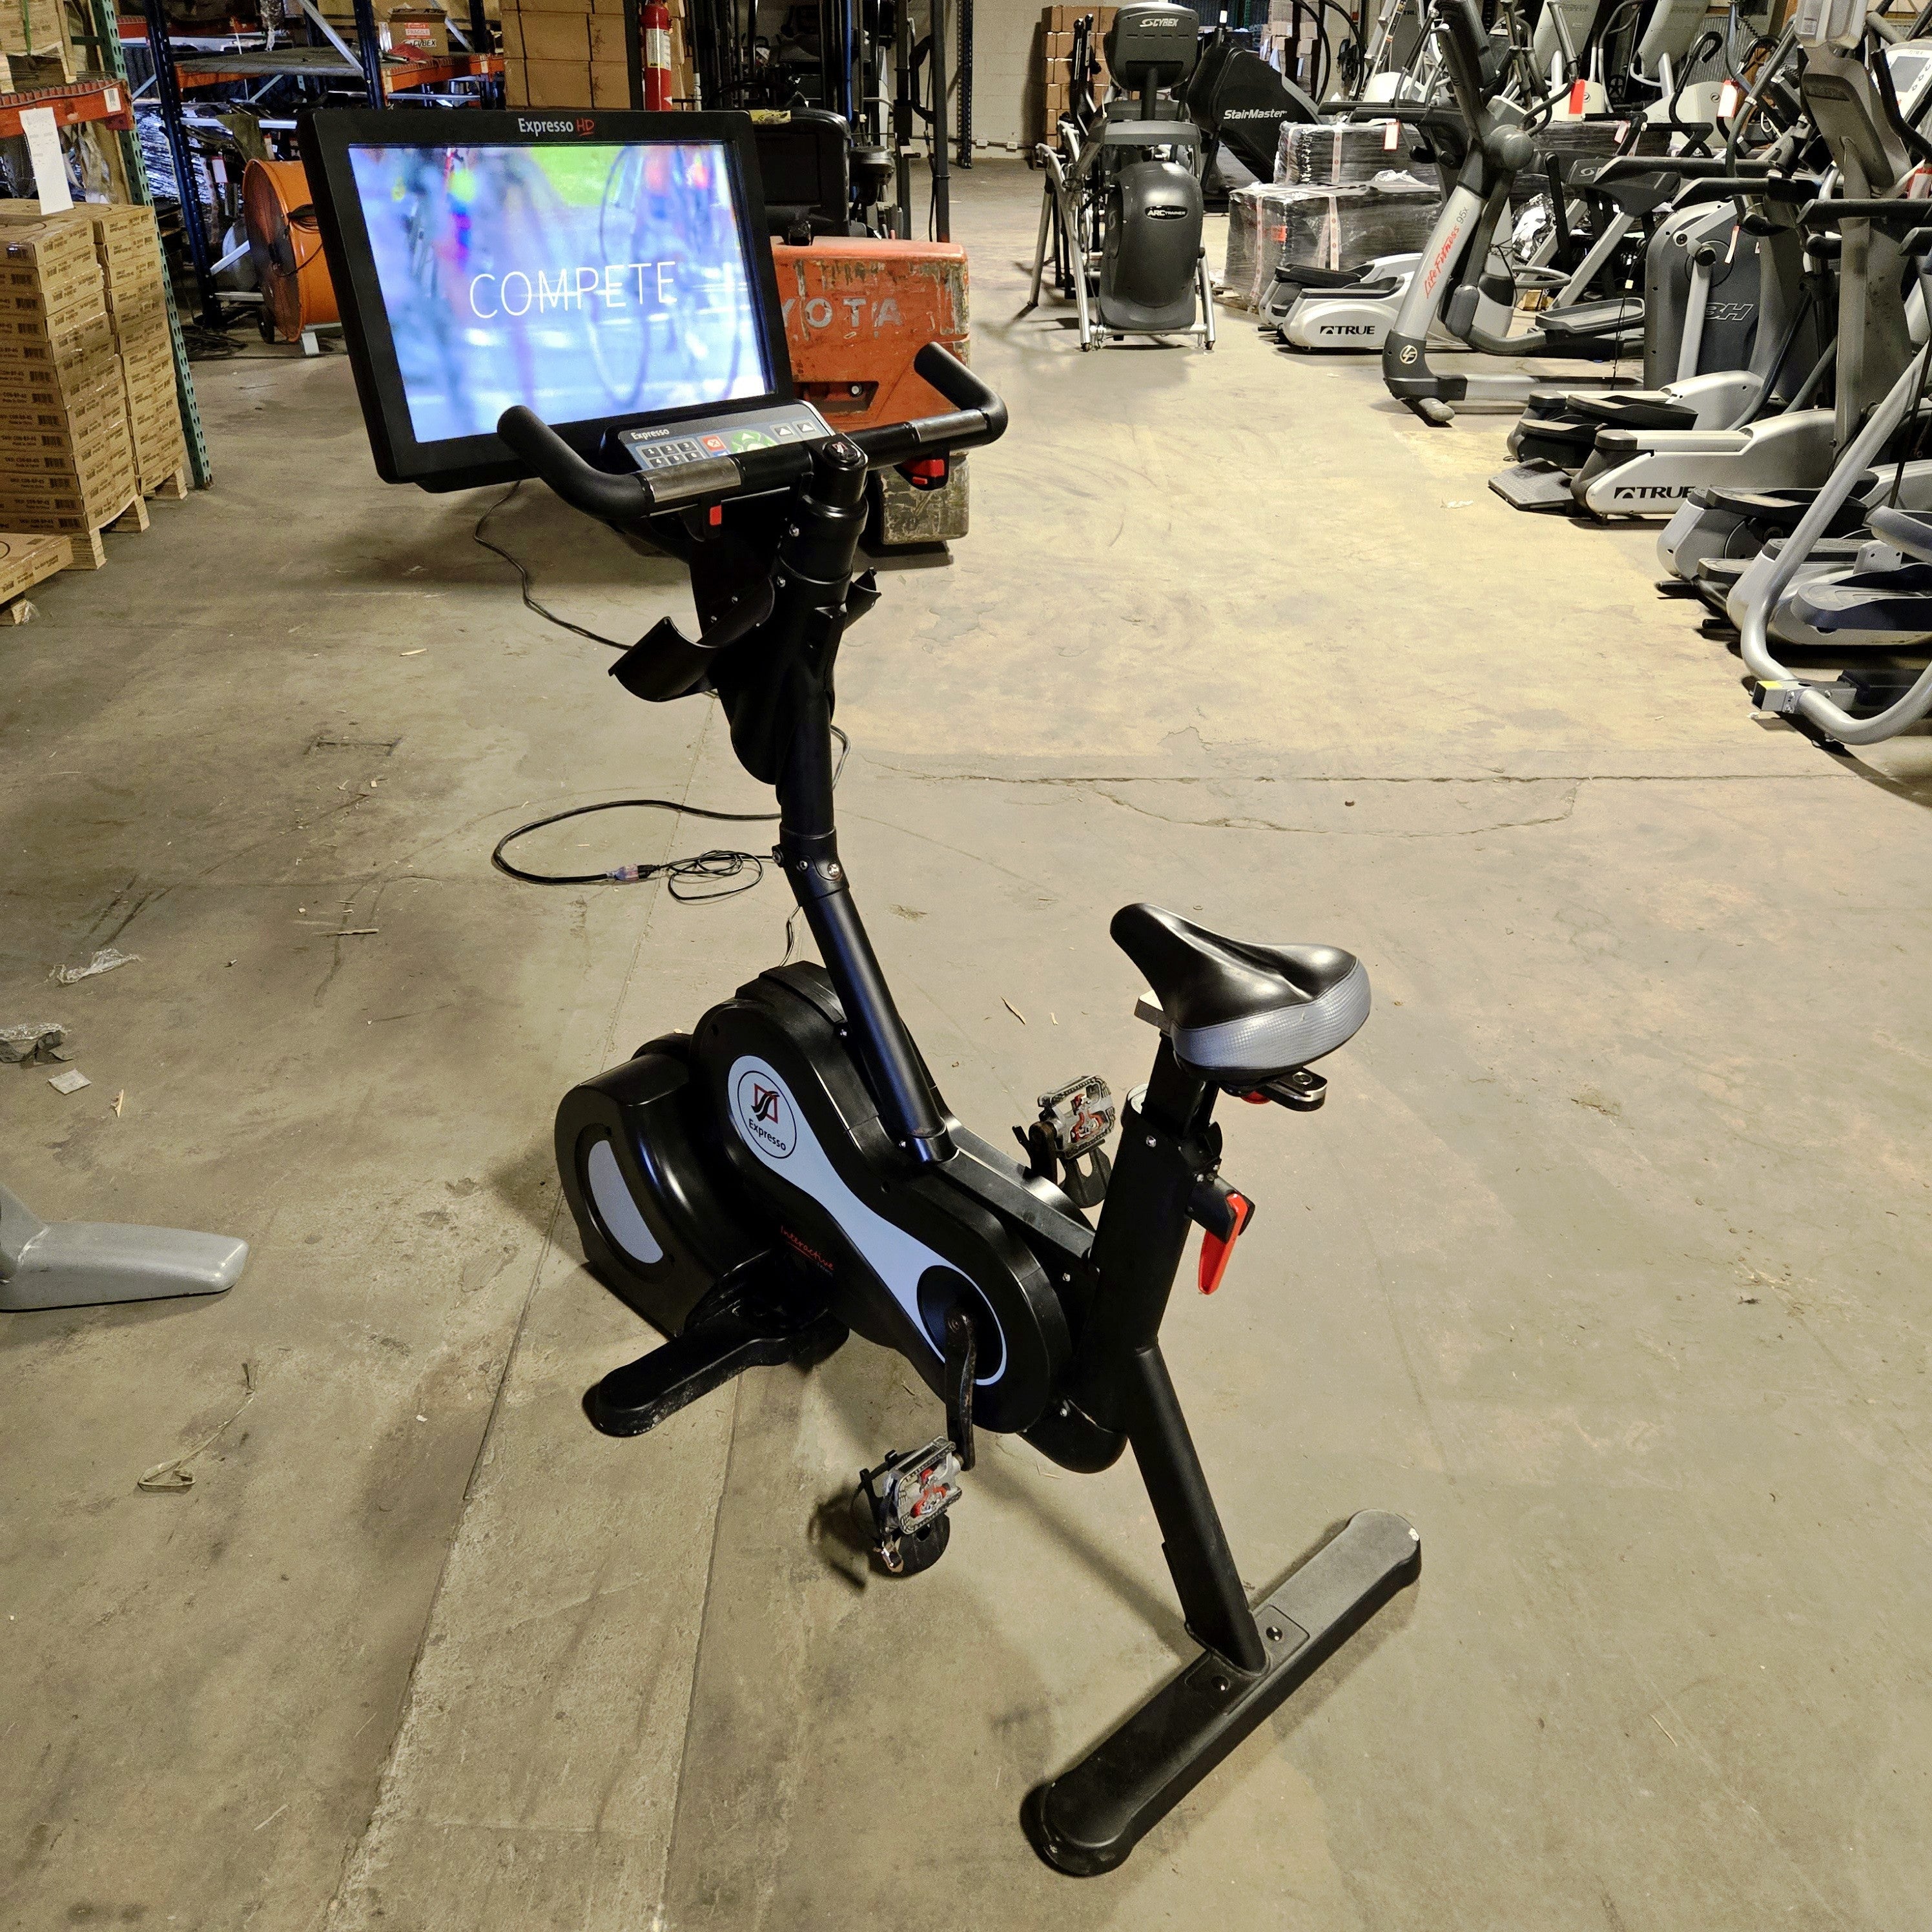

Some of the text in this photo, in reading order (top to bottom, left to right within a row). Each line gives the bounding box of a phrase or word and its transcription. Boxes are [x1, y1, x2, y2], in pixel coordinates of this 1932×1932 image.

[1152, 18, 1179, 27] CYBEX
[1223, 108, 1285, 119] StairMaster
[518, 118, 595, 137] Expresso HD
[469, 260, 678, 319] COMPETE
[781, 298, 903, 328] YOTA
[1335, 325, 1375, 334] TRUE
[630, 427, 670, 441] Expresso
[748, 1118, 786, 1151] Expresso
[781, 1225, 834, 1271] Interactive
